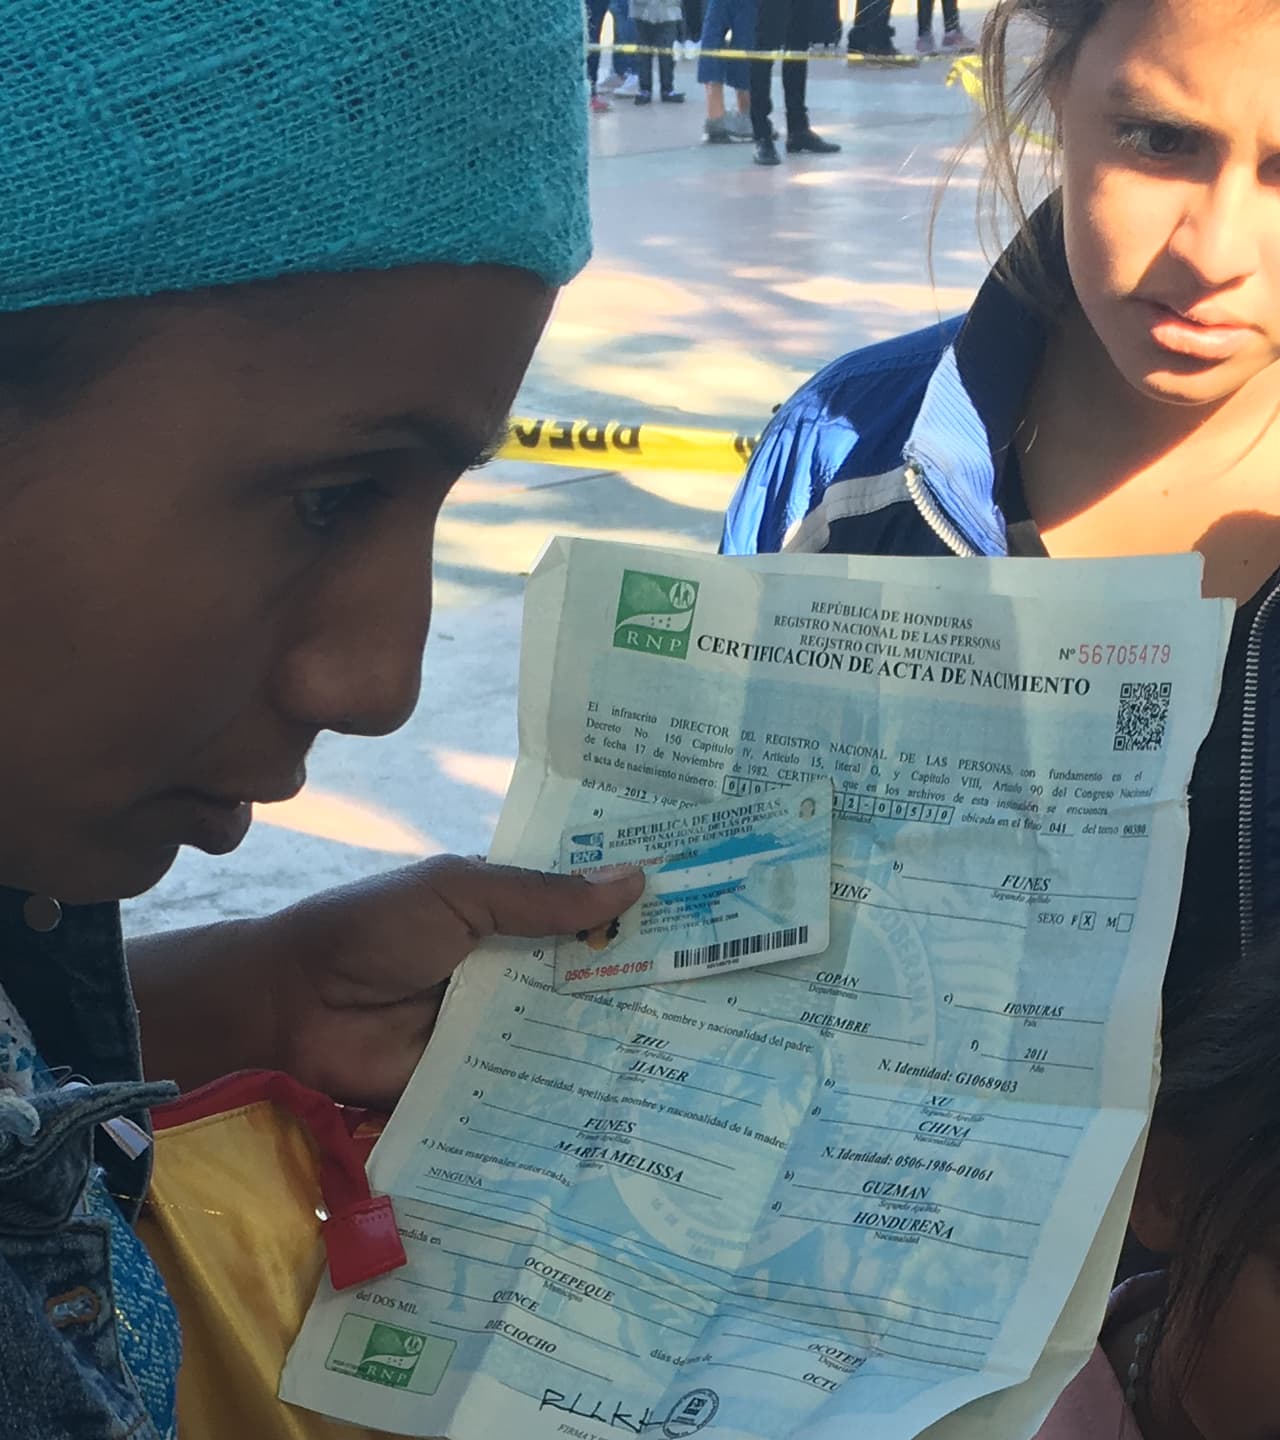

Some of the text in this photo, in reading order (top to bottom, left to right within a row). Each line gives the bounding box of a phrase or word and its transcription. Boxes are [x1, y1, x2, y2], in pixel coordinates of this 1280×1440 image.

[881, 609, 900, 622] DE
[903, 612, 973, 630] HONDURAS
[626, 630, 682, 651] RNP
[774, 615, 1001, 651] REGISTRO NACIONAL DE LAS PERSONAS
[800, 634, 975, 665] REGISTRO CIVIL MUNICIPAL
[1078, 644, 1171, 665] 56705479
[848, 657, 874, 675] DE
[878, 660, 934, 682] ACTA
[941, 667, 966, 685] DE
[970, 669, 1090, 696] NACIMIENTO
[586, 717, 622, 734] Decreto
[664, 733, 682, 746] 150
[835, 759, 861, 773] literal
[1030, 785, 1043, 796] 90
[1052, 786, 1067, 797] del
[670, 717, 729, 738] DIRECTOR
[765, 733, 820, 750] REGISTRO
[830, 742, 888, 760] NACIONAL
[899, 752, 916, 765] DE
[926, 755, 948, 768] LAS
[1049, 768, 1103, 782] fundamento
[583, 751, 592, 763] el
[593, 754, 612, 767] acta
[614, 758, 625, 770] de
[626, 761, 677, 781] nacimiento
[584, 734, 596, 745] de
[603, 737, 627, 751] fecha
[635, 743, 646, 755] 17
[653, 747, 665, 760] de
[672, 749, 725, 771] Noviembre
[843, 779, 859, 791] que
[866, 783, 877, 793] en
[886, 783, 899, 796] los
[907, 788, 945, 801] archivos
[953, 793, 965, 804] de
[582, 777, 677, 808] del Año 2012 que
[692, 813, 709, 827] DE
[711, 799, 781, 823] HONDURAS
[608, 834, 657, 850] REGISTRO
[657, 824, 706, 843] NACIONAL
[708, 821, 720, 832] DE
[644, 824, 753, 853] TARJETA DE IDENTIDAD
[831, 881, 871, 900] YING
[1001, 874, 1051, 892] FUNES
[1037, 913, 1065, 925] SEXO
[1004, 1002, 1064, 1017] HONDURAS
[662, 1012, 697, 1028] nombre
[708, 1021, 766, 1045] nacionalidad
[769, 1034, 782, 1046] del
[800, 1010, 870, 1034] DICIEMBRE
[631, 1033, 669, 1049] ZHU
[1024, 1048, 1048, 1061] 2011
[629, 1060, 689, 1083] JIANER
[894, 1059, 954, 1083] Identidad:
[480, 1061, 517, 1080] Número
[518, 1070, 529, 1081] de
[667, 1105, 727, 1130] nacionalidad
[729, 1120, 742, 1132] de
[744, 1127, 752, 1138] la
[925, 1095, 952, 1107] XU
[584, 1117, 636, 1134] FUNES
[919, 1119, 972, 1139] CHINA
[436, 1141, 464, 1157] Notas
[609, 1150, 685, 1183] MELISSA
[836, 1146, 893, 1166] Identidad:
[895, 1155, 995, 1182] 0506-1986-01061
[428, 1167, 483, 1187] NINGUNA
[862, 1180, 930, 1200] GUZMAN
[853, 1211, 955, 1240] HONDUREÑA
[429, 1235, 441, 1245] en
[524, 1256, 616, 1302] OCOTEPEQUE
[356, 1290, 419, 1315] del DOS MIL
[492, 1289, 540, 1313] QUINCE
[484, 1319, 557, 1354] DIECIOCHO
[367, 1365, 407, 1383] RNP
[557, 1424, 588, 1440] FIRMA
